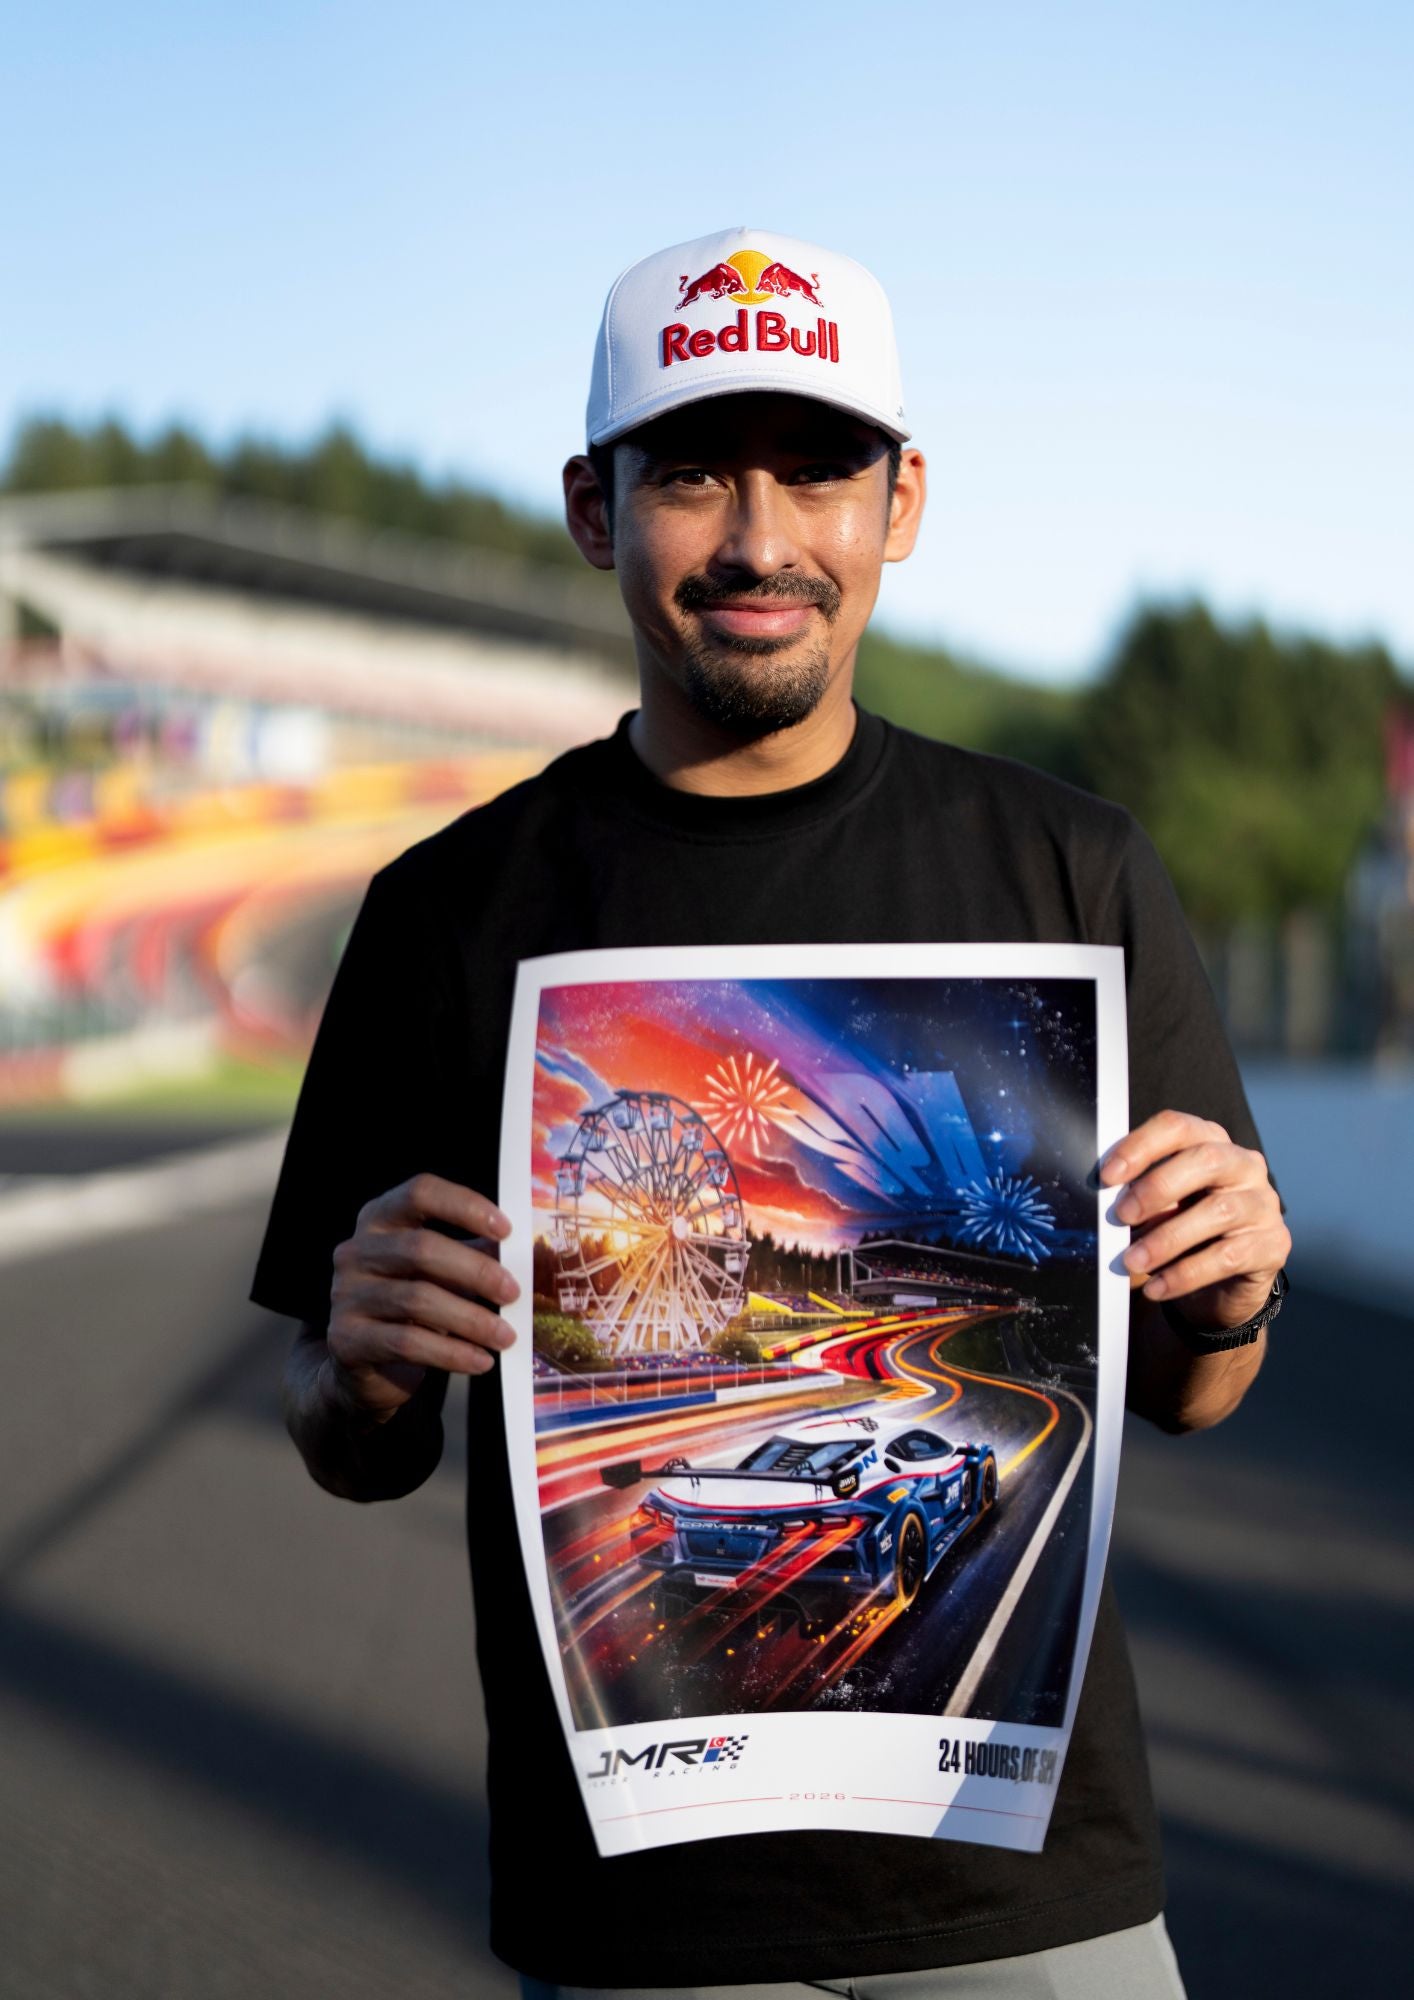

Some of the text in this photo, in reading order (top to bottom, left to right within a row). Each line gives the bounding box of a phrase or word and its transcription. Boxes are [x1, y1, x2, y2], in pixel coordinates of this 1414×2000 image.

[662, 308, 840, 367] Red Bull
[587, 1738, 708, 1779] JMR
[653, 1763, 738, 1778] RACING
[938, 1738, 961, 1773] 24
[964, 1741, 1020, 1780] HOURS
[1021, 1747, 1039, 1782] OF
[790, 1792, 846, 1800] 2026
